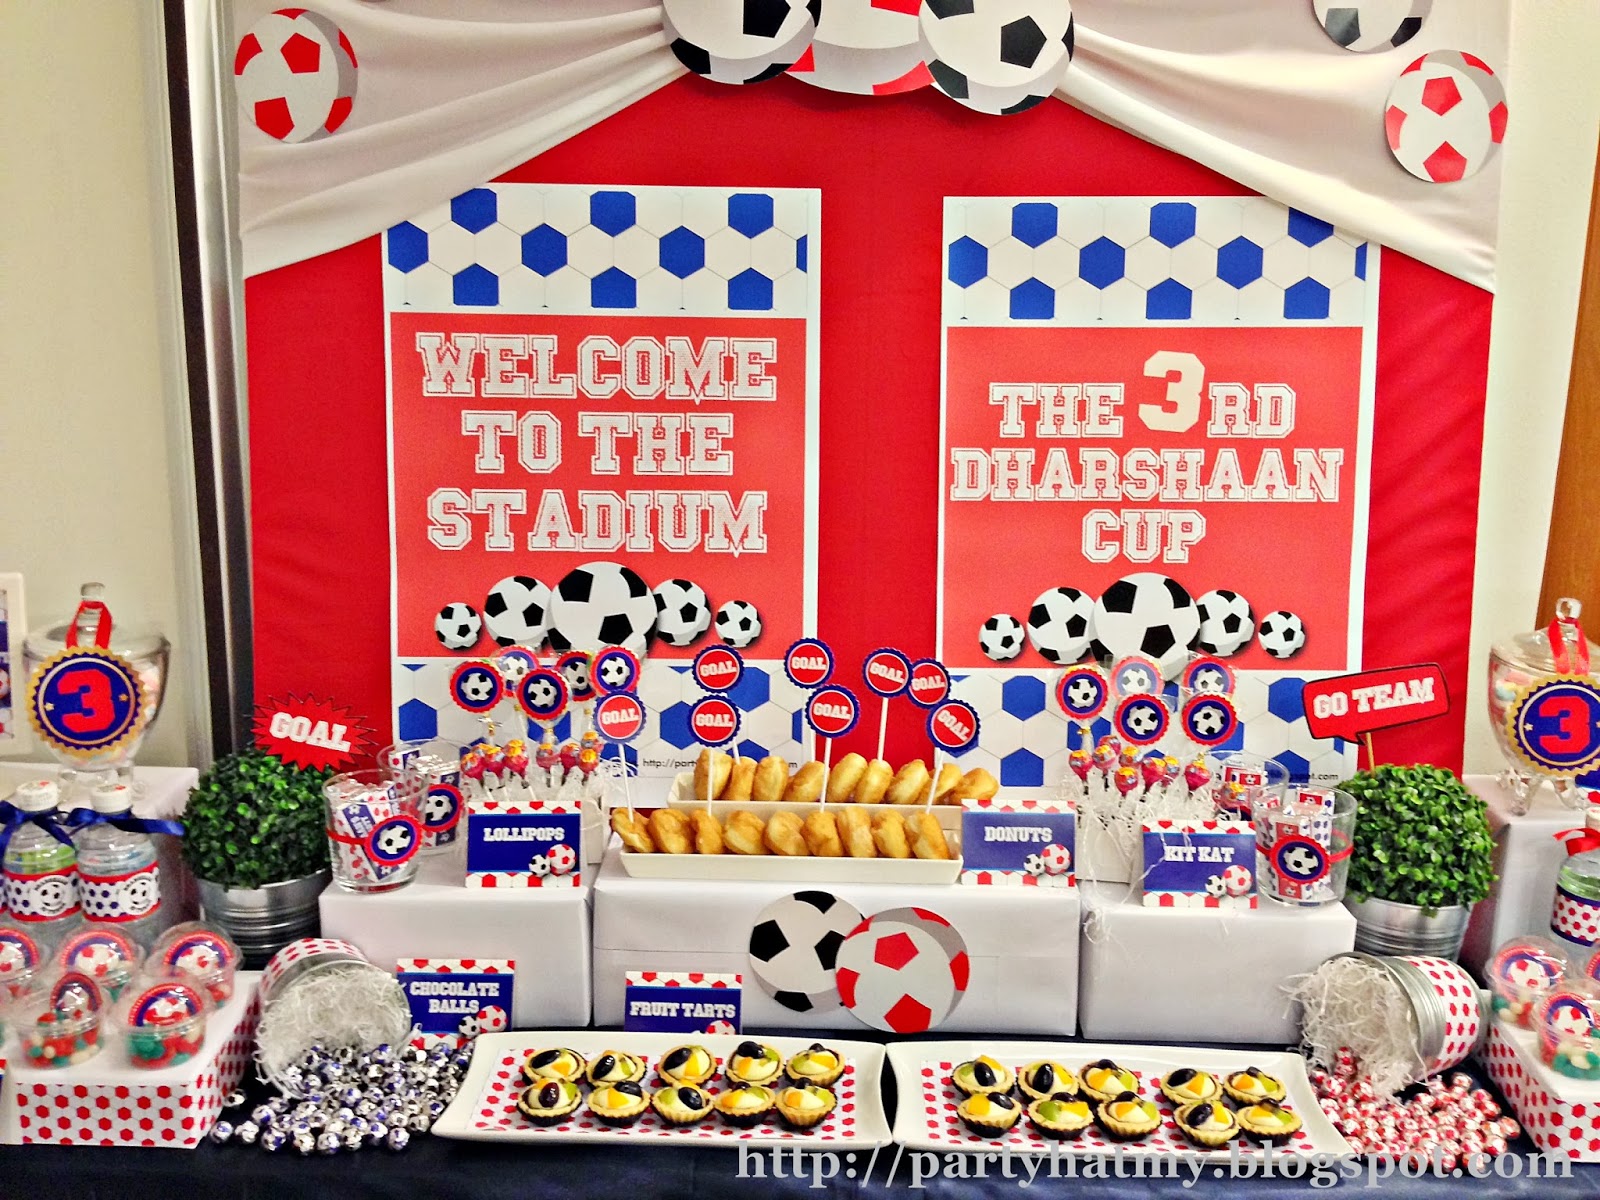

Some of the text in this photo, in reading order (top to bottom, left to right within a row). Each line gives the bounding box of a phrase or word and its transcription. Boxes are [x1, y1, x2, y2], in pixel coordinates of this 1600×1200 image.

[415, 331, 778, 405] WELCOME
[988, 381, 1125, 438] THE
[461, 410, 734, 476] TO THE
[949, 447, 1344, 502] DHARSHAAN
[426, 487, 768, 558] STADIUM
[1081, 508, 1207, 564] CUP
[699, 660, 737, 677] GOAL
[790, 656, 828, 671] GOAL
[869, 662, 906, 684] GOAL
[911, 674, 946, 691] GOAL
[56, 668, 115, 733] 3
[1313, 677, 1435, 720] GO TEAM
[601, 708, 640, 725] GOAL
[695, 713, 734, 728] GOAL
[813, 703, 852, 720] GOAL
[269, 710, 352, 754] GOAL
[937, 708, 971, 743] GOAL
[1538, 695, 1591, 754] 3
[483, 827, 565, 842] LOLLIPOPS
[984, 826, 1053, 842] DONUTS
[1164, 845, 1235, 863] KIT KAT
[409, 981, 500, 997] CHOCOLATE
[428, 998, 480, 1015] BALLS
[630, 1001, 737, 1018] FRUIT TARTS
